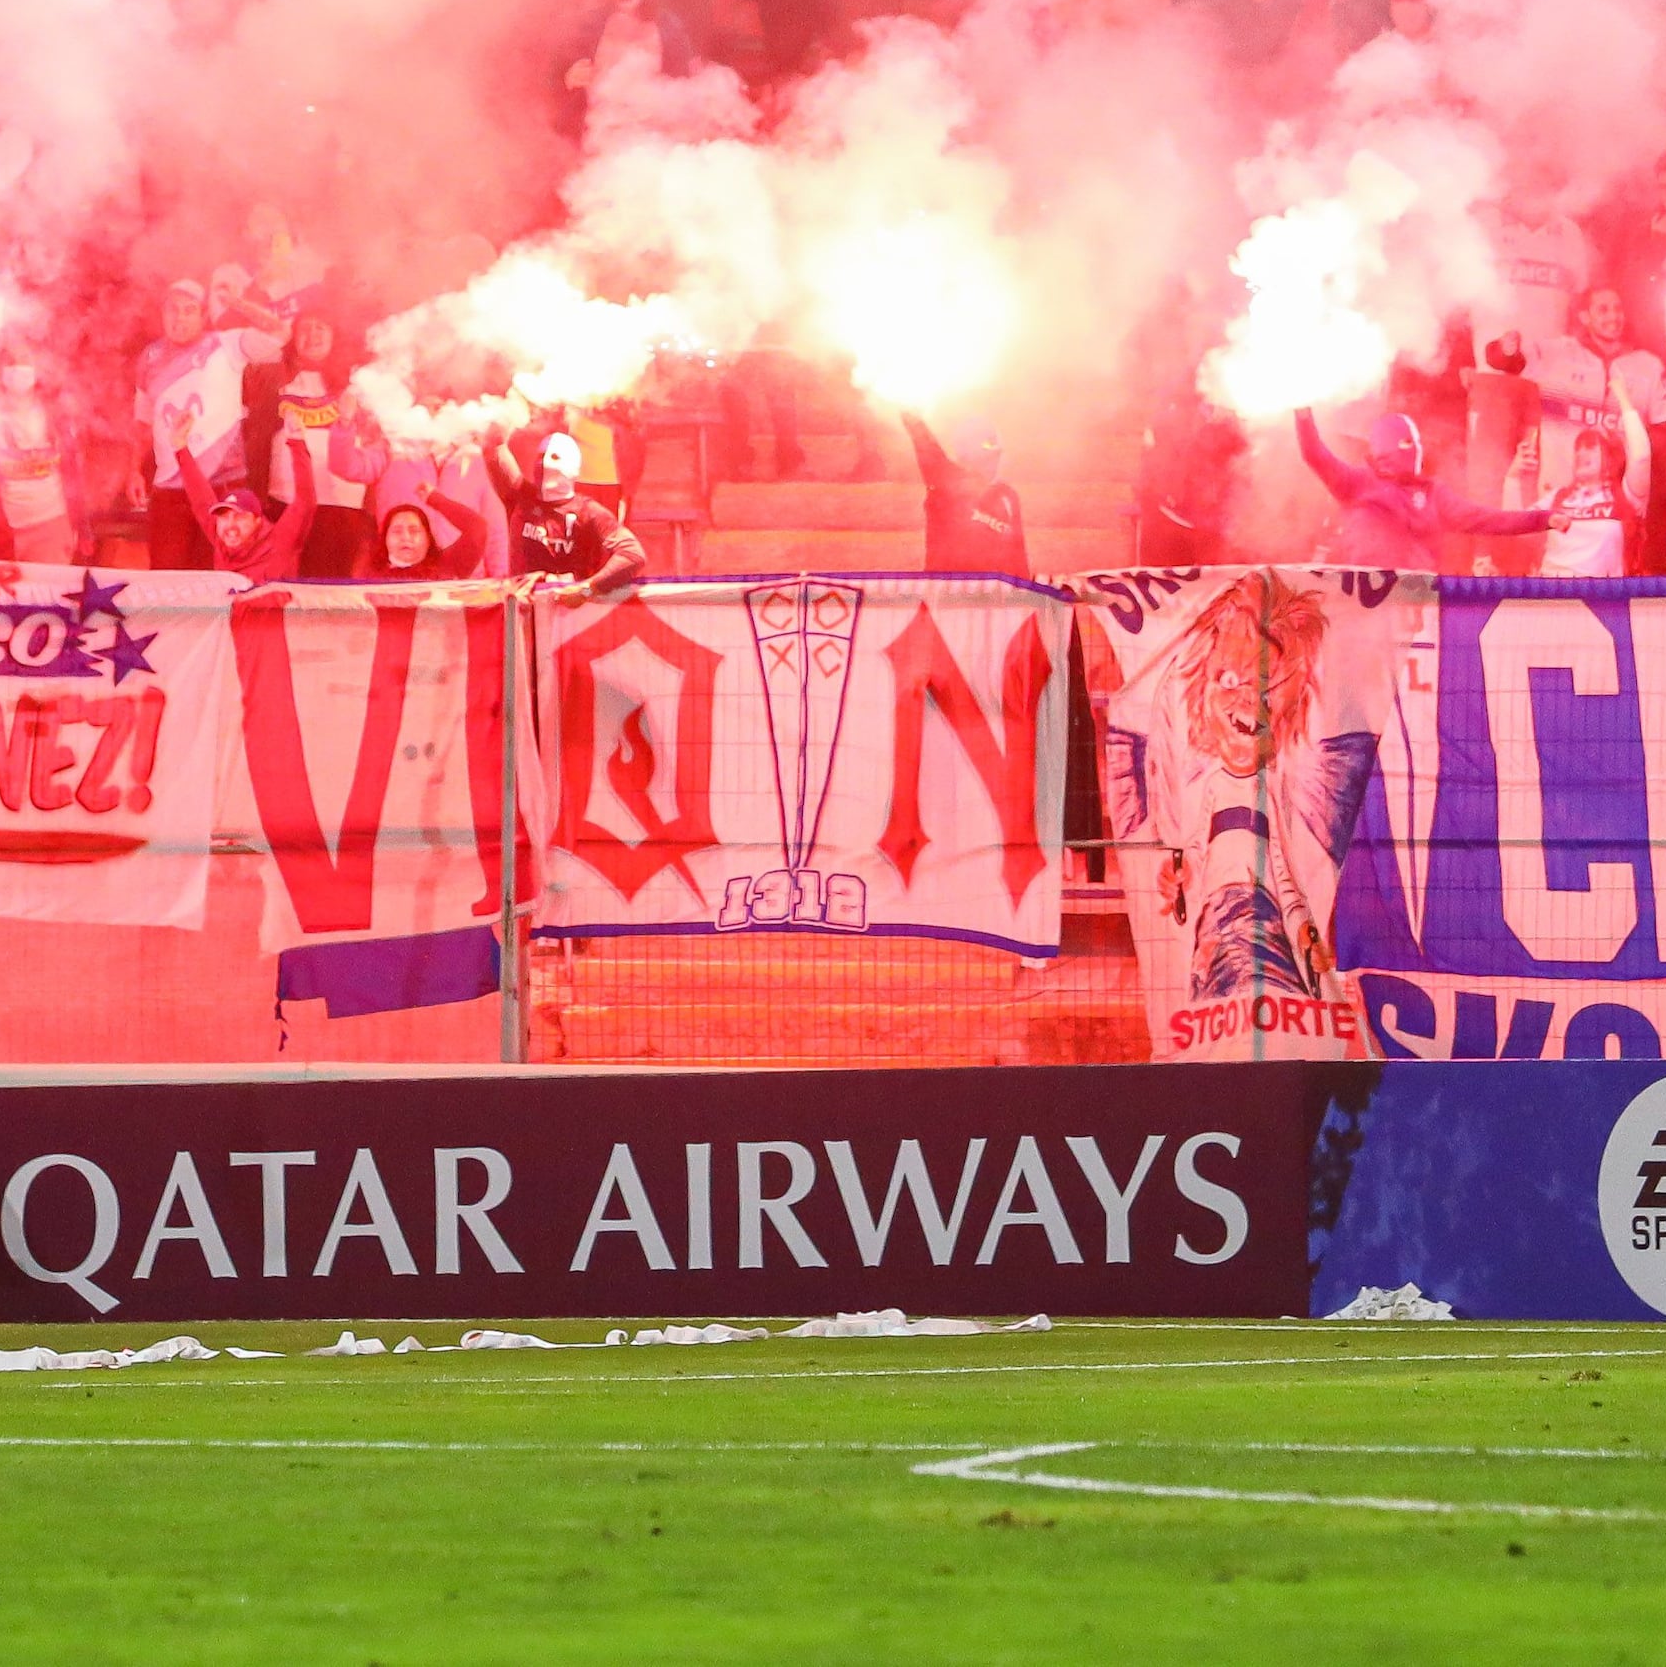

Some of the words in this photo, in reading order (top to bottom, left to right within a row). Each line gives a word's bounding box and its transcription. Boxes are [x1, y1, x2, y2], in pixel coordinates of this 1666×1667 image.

[521, 520, 575, 555] DIRTV
[717, 869, 869, 930] 1312
[1168, 1005, 1237, 1050] STGO
[1, 1146, 526, 1313] QATAR
[570, 1132, 1249, 1272] AIRWAYS
